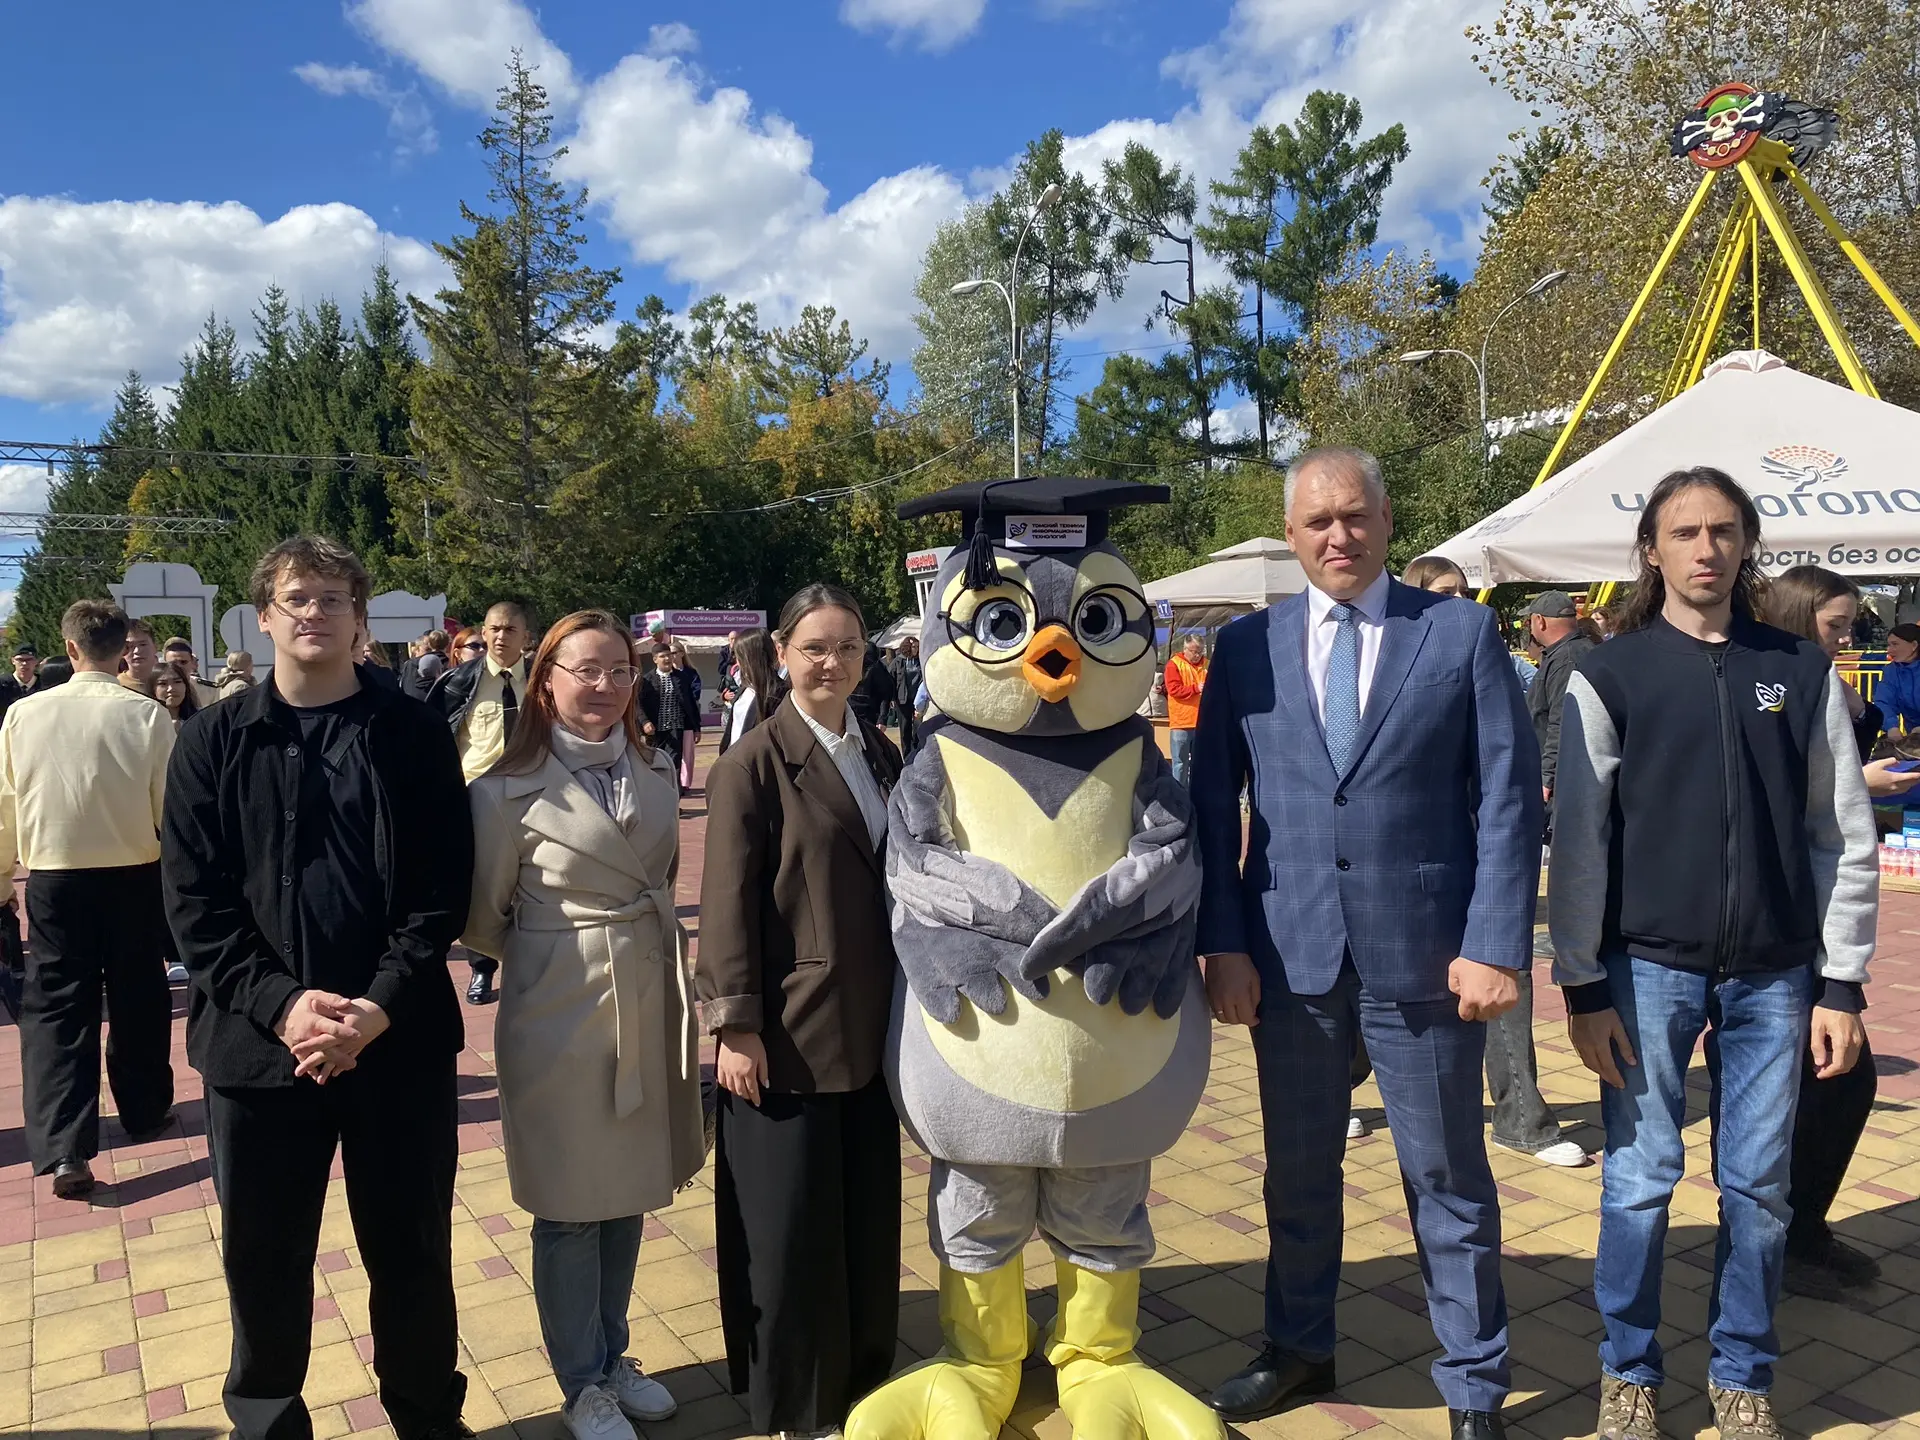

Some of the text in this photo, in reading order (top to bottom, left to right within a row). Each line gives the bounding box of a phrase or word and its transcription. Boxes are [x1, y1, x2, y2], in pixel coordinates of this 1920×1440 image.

[1758, 550, 1821, 567] ость
[1828, 543, 1878, 565] без
[1158, 603, 1168, 614] 17
[677, 614, 756, 622] Мороженое Коктейли
